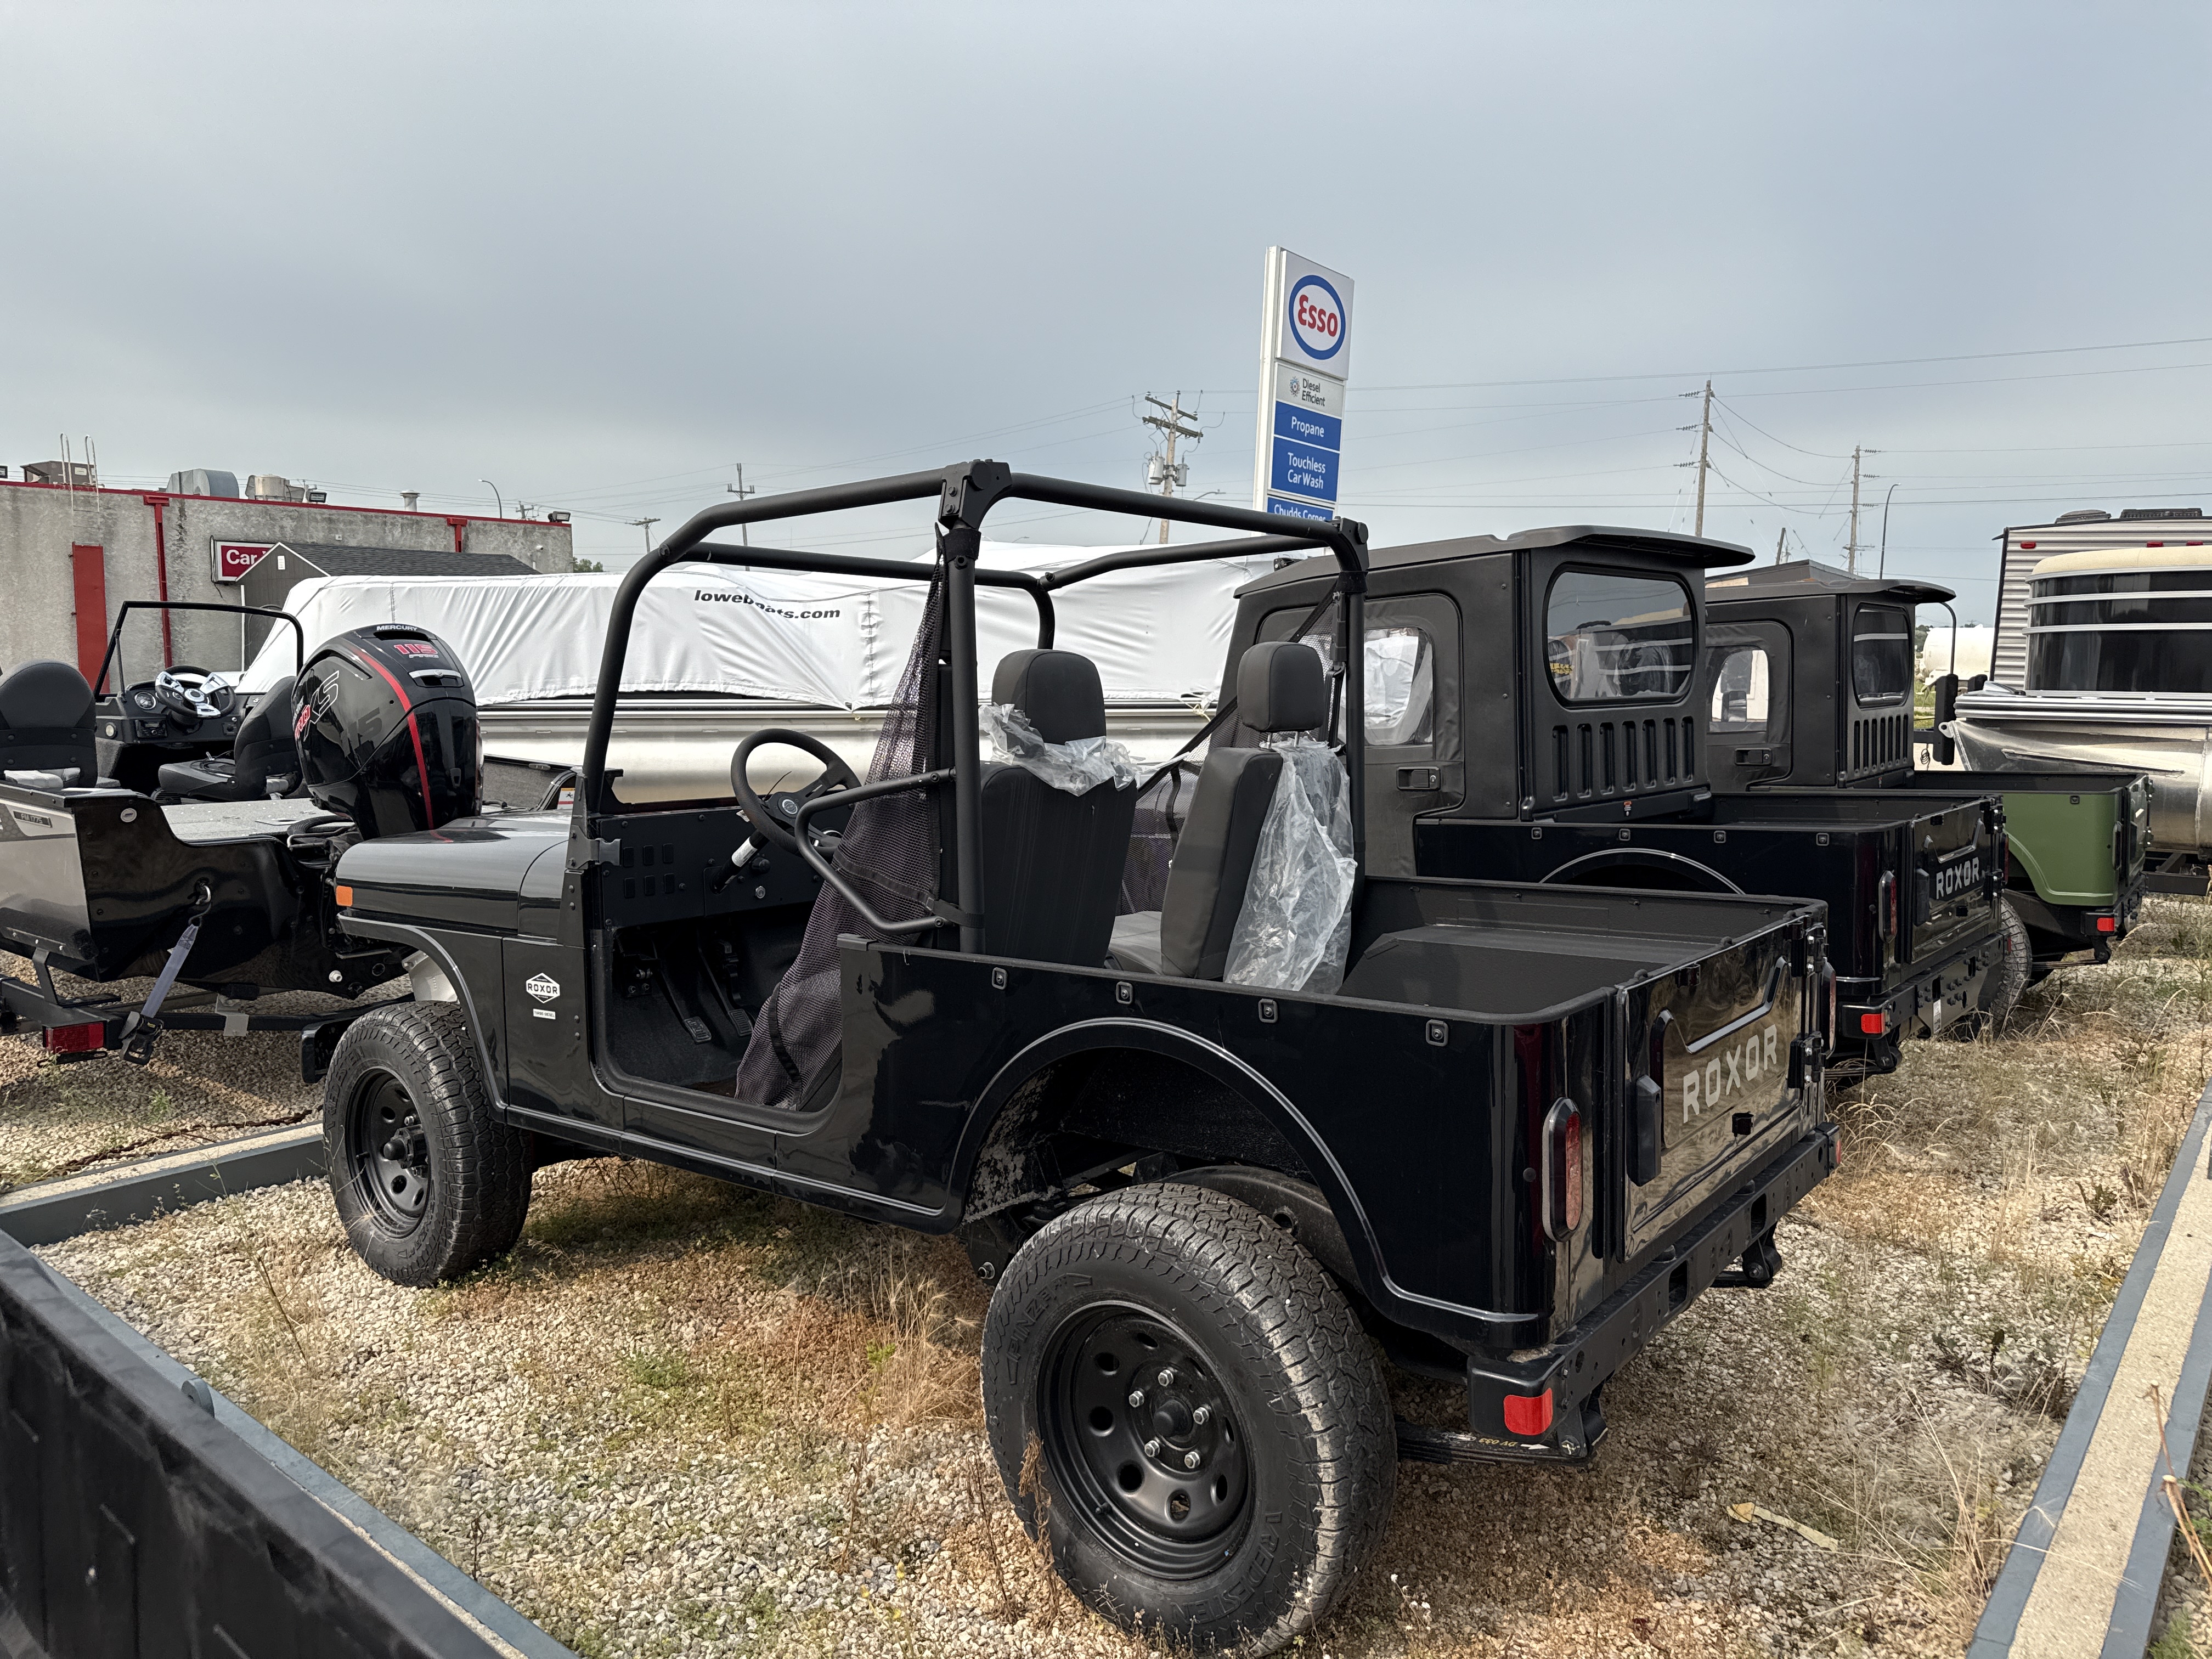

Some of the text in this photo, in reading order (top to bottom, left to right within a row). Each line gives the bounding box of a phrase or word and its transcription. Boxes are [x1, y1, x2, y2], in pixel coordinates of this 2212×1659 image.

[1302, 378, 1320, 393] Diesel
[1301, 390, 1325, 407] Efficient
[1291, 416, 1324, 437] Propane
[1288, 452, 1326, 473] Touchless
[1288, 469, 1324, 489] Car Wash
[1274, 504, 1302, 518] Chudds
[226, 549, 258, 565] Car
[393, 644, 438, 654] 115
[1936, 856, 1979, 900] ROXOR
[527, 983, 558, 995] ROXOR
[1683, 1024, 1777, 1124] ROXOR
